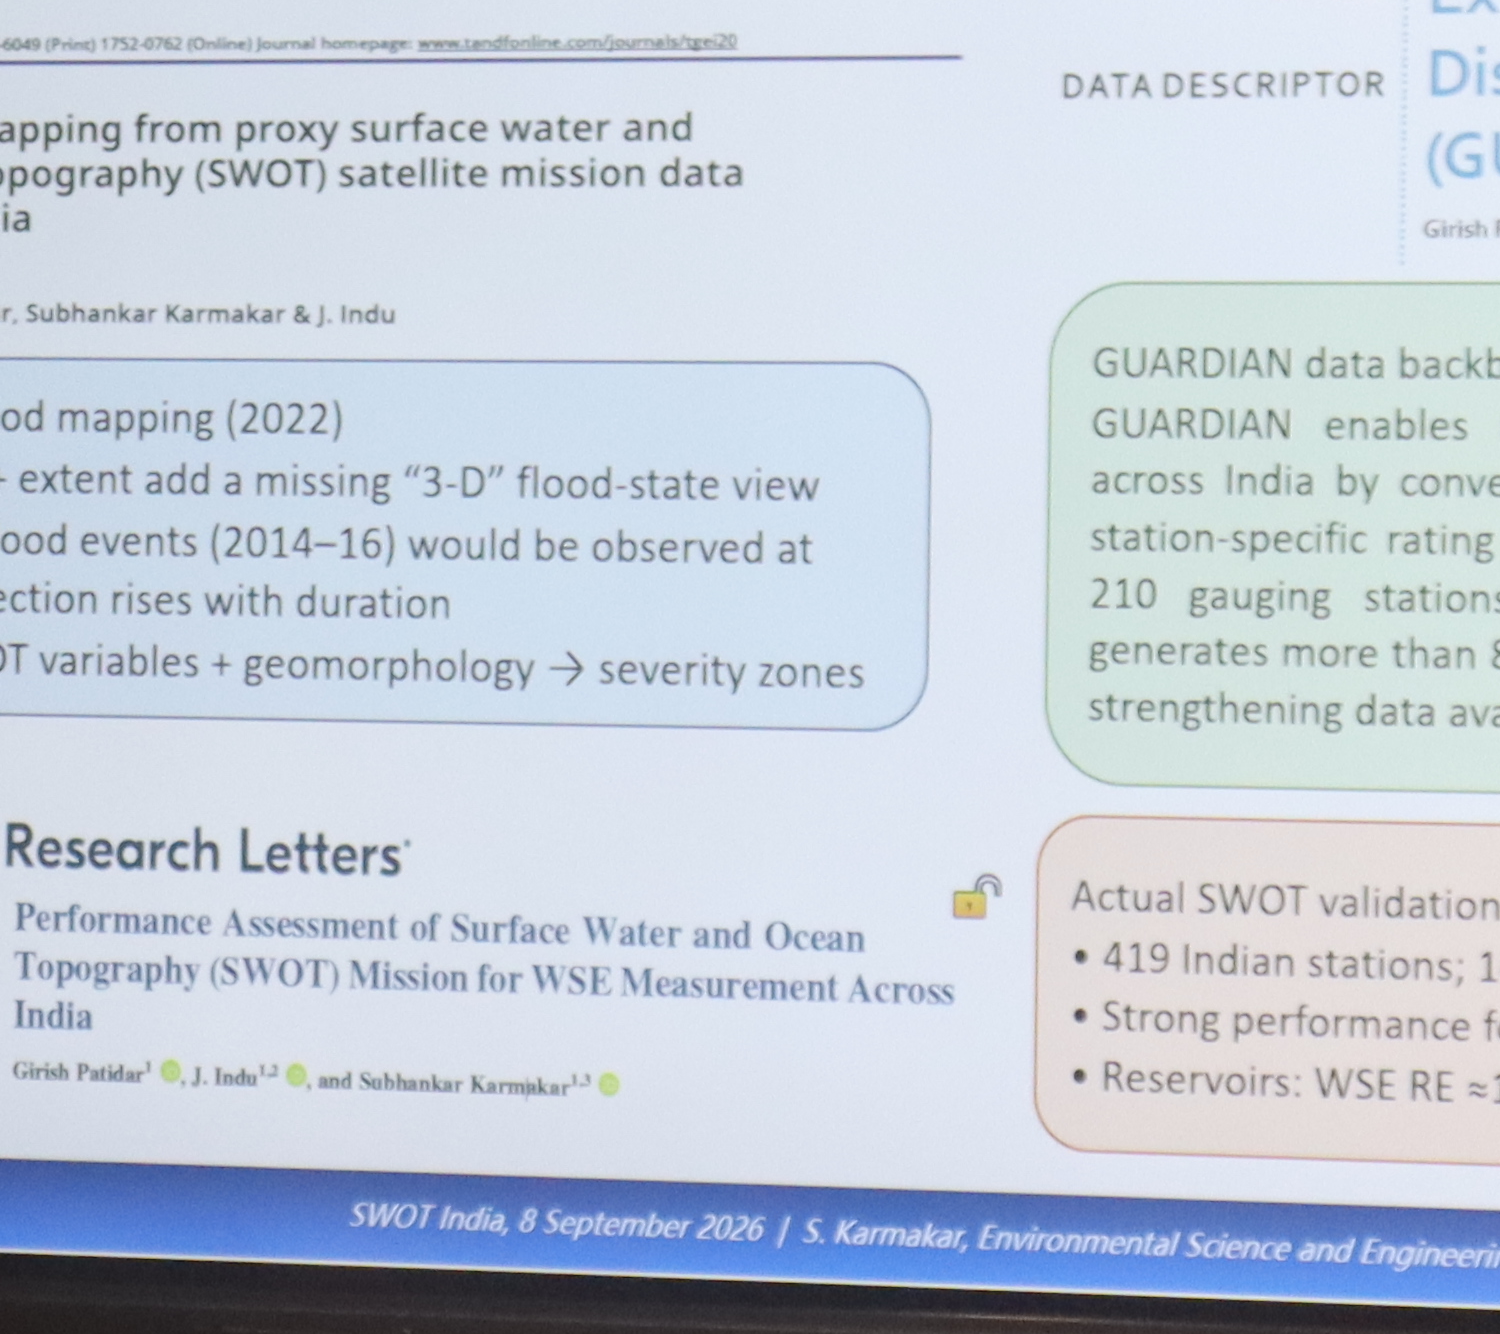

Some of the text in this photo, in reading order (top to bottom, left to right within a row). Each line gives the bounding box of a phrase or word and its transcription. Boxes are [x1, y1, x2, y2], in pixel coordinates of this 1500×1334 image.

[1062, 69, 1385, 100] DATA DESCRIPTOR
[134, 111, 223, 145] from
[235, 119, 340, 153] proxy
[351, 111, 489, 144] surface
[500, 115, 612, 144] water
[622, 110, 693, 143] and
[195, 157, 328, 194] (SWOT)
[338, 156, 489, 189] satellite
[501, 157, 647, 188] mission
[659, 155, 744, 189] data
[1092, 345, 1292, 380] GUARDIAN
[1304, 345, 1386, 380] data
[58, 399, 216, 442] mapping
[226, 398, 344, 443] (2022)
[1091, 406, 1292, 441] GUARDIAN
[1323, 407, 1469, 442] enables
[80, 526, 199, 558] events
[408, 526, 522, 562] would
[535, 527, 580, 563] be
[591, 528, 765, 566] observed
[777, 533, 814, 566] at
[5, 821, 221, 873] Research
[1070, 879, 1185, 914] Actual
[1198, 881, 1309, 917] SWOT
[15, 901, 866, 954] Performance Assessment of Surface Water and Ocean
[14, 950, 956, 1006] Topography (SWOT) Mission for WSE Measurement Across
[1103, 940, 1171, 975] 419
[1182, 942, 1295, 978] Indian
[1307, 949, 1464, 988] stations;
[14, 999, 93, 1032] India
[349, 1201, 437, 1230] SWOT
[440, 1205, 508, 1238] India,
[520, 1206, 539, 1231] 8
[546, 1207, 689, 1242] September
[697, 1212, 766, 1243] 2026
[805, 1215, 824, 1246] S.
[835, 1217, 967, 1255] Karmakar,
[980, 1220, 1182, 1258] Environmental
[1188, 1229, 1290, 1262] Science
[1299, 1236, 1358, 1263] and
